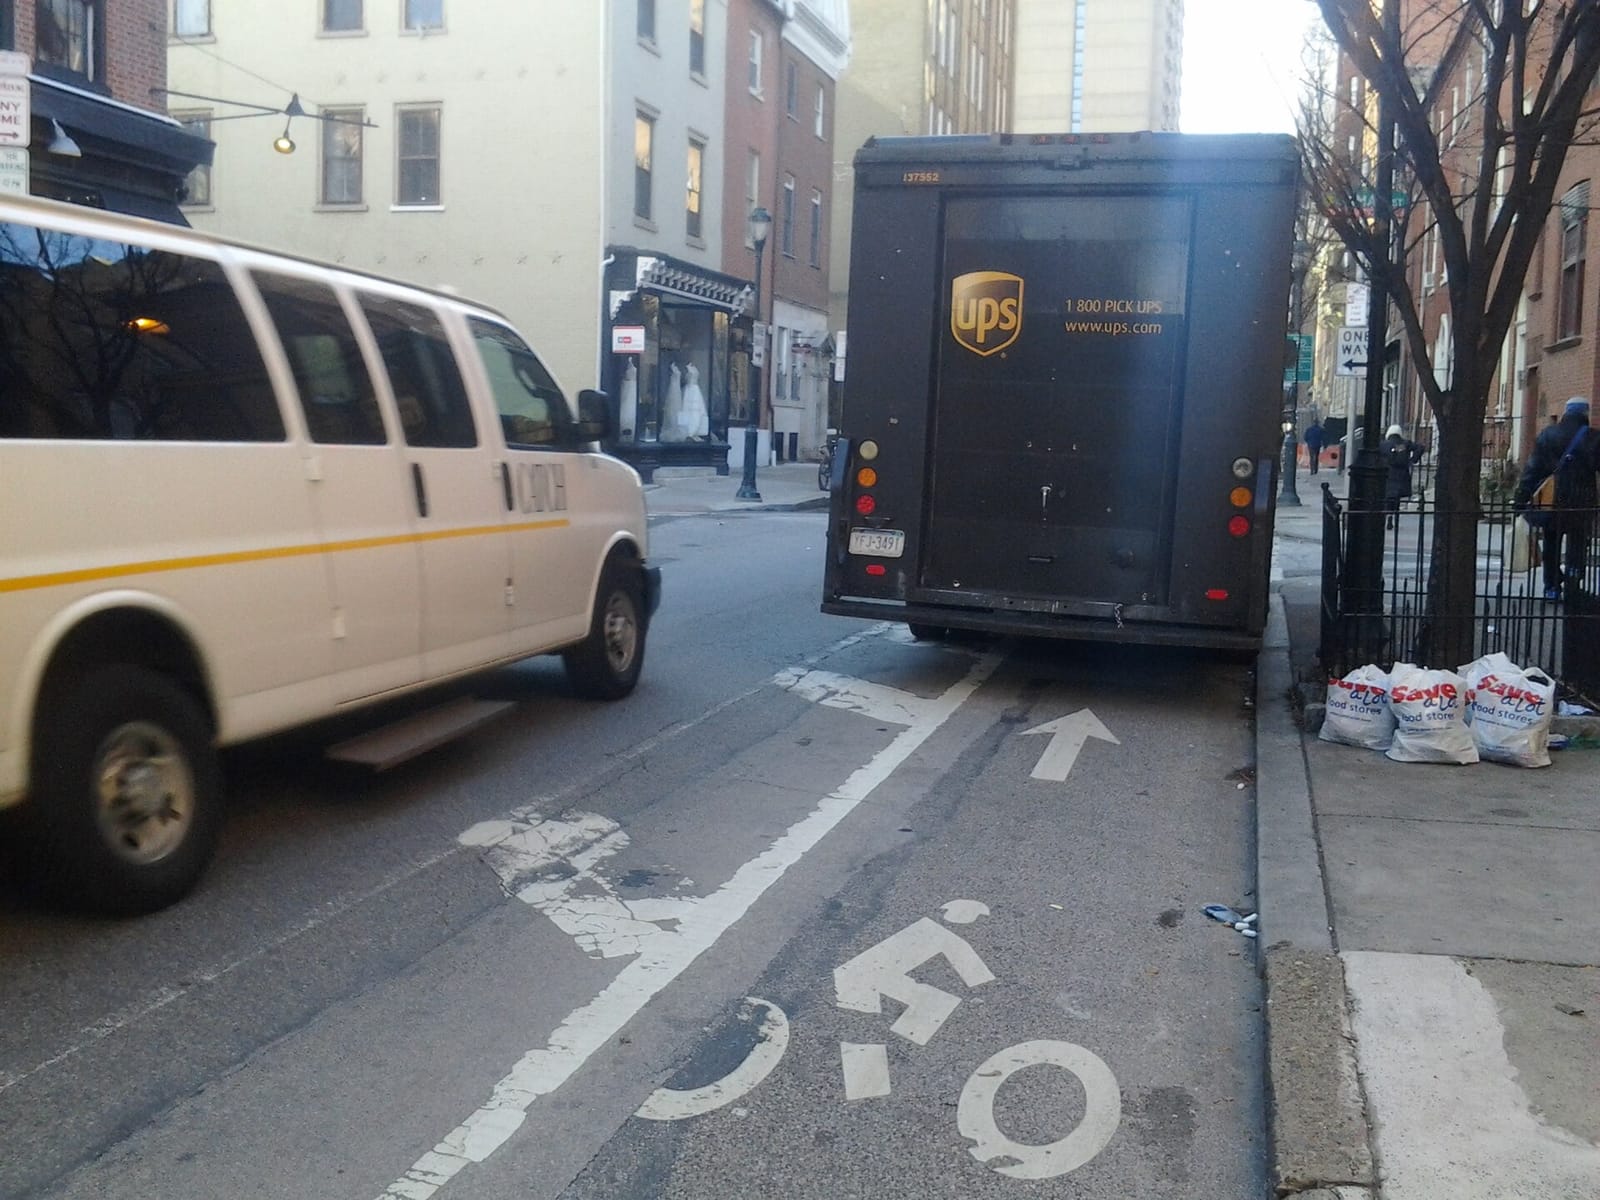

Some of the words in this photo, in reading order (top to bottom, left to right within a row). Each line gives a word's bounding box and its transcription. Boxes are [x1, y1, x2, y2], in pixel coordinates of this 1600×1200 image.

[0, 101, 20, 112] NY
[1065, 299, 1072, 313] 1
[1077, 299, 1101, 313] 800
[1104, 300, 1133, 313] PICK
[1137, 300, 1162, 314] UPS
[1065, 322, 1162, 336] www.ups.com
[1391, 683, 1458, 704] Save
[1497, 710, 1534, 725] stores
